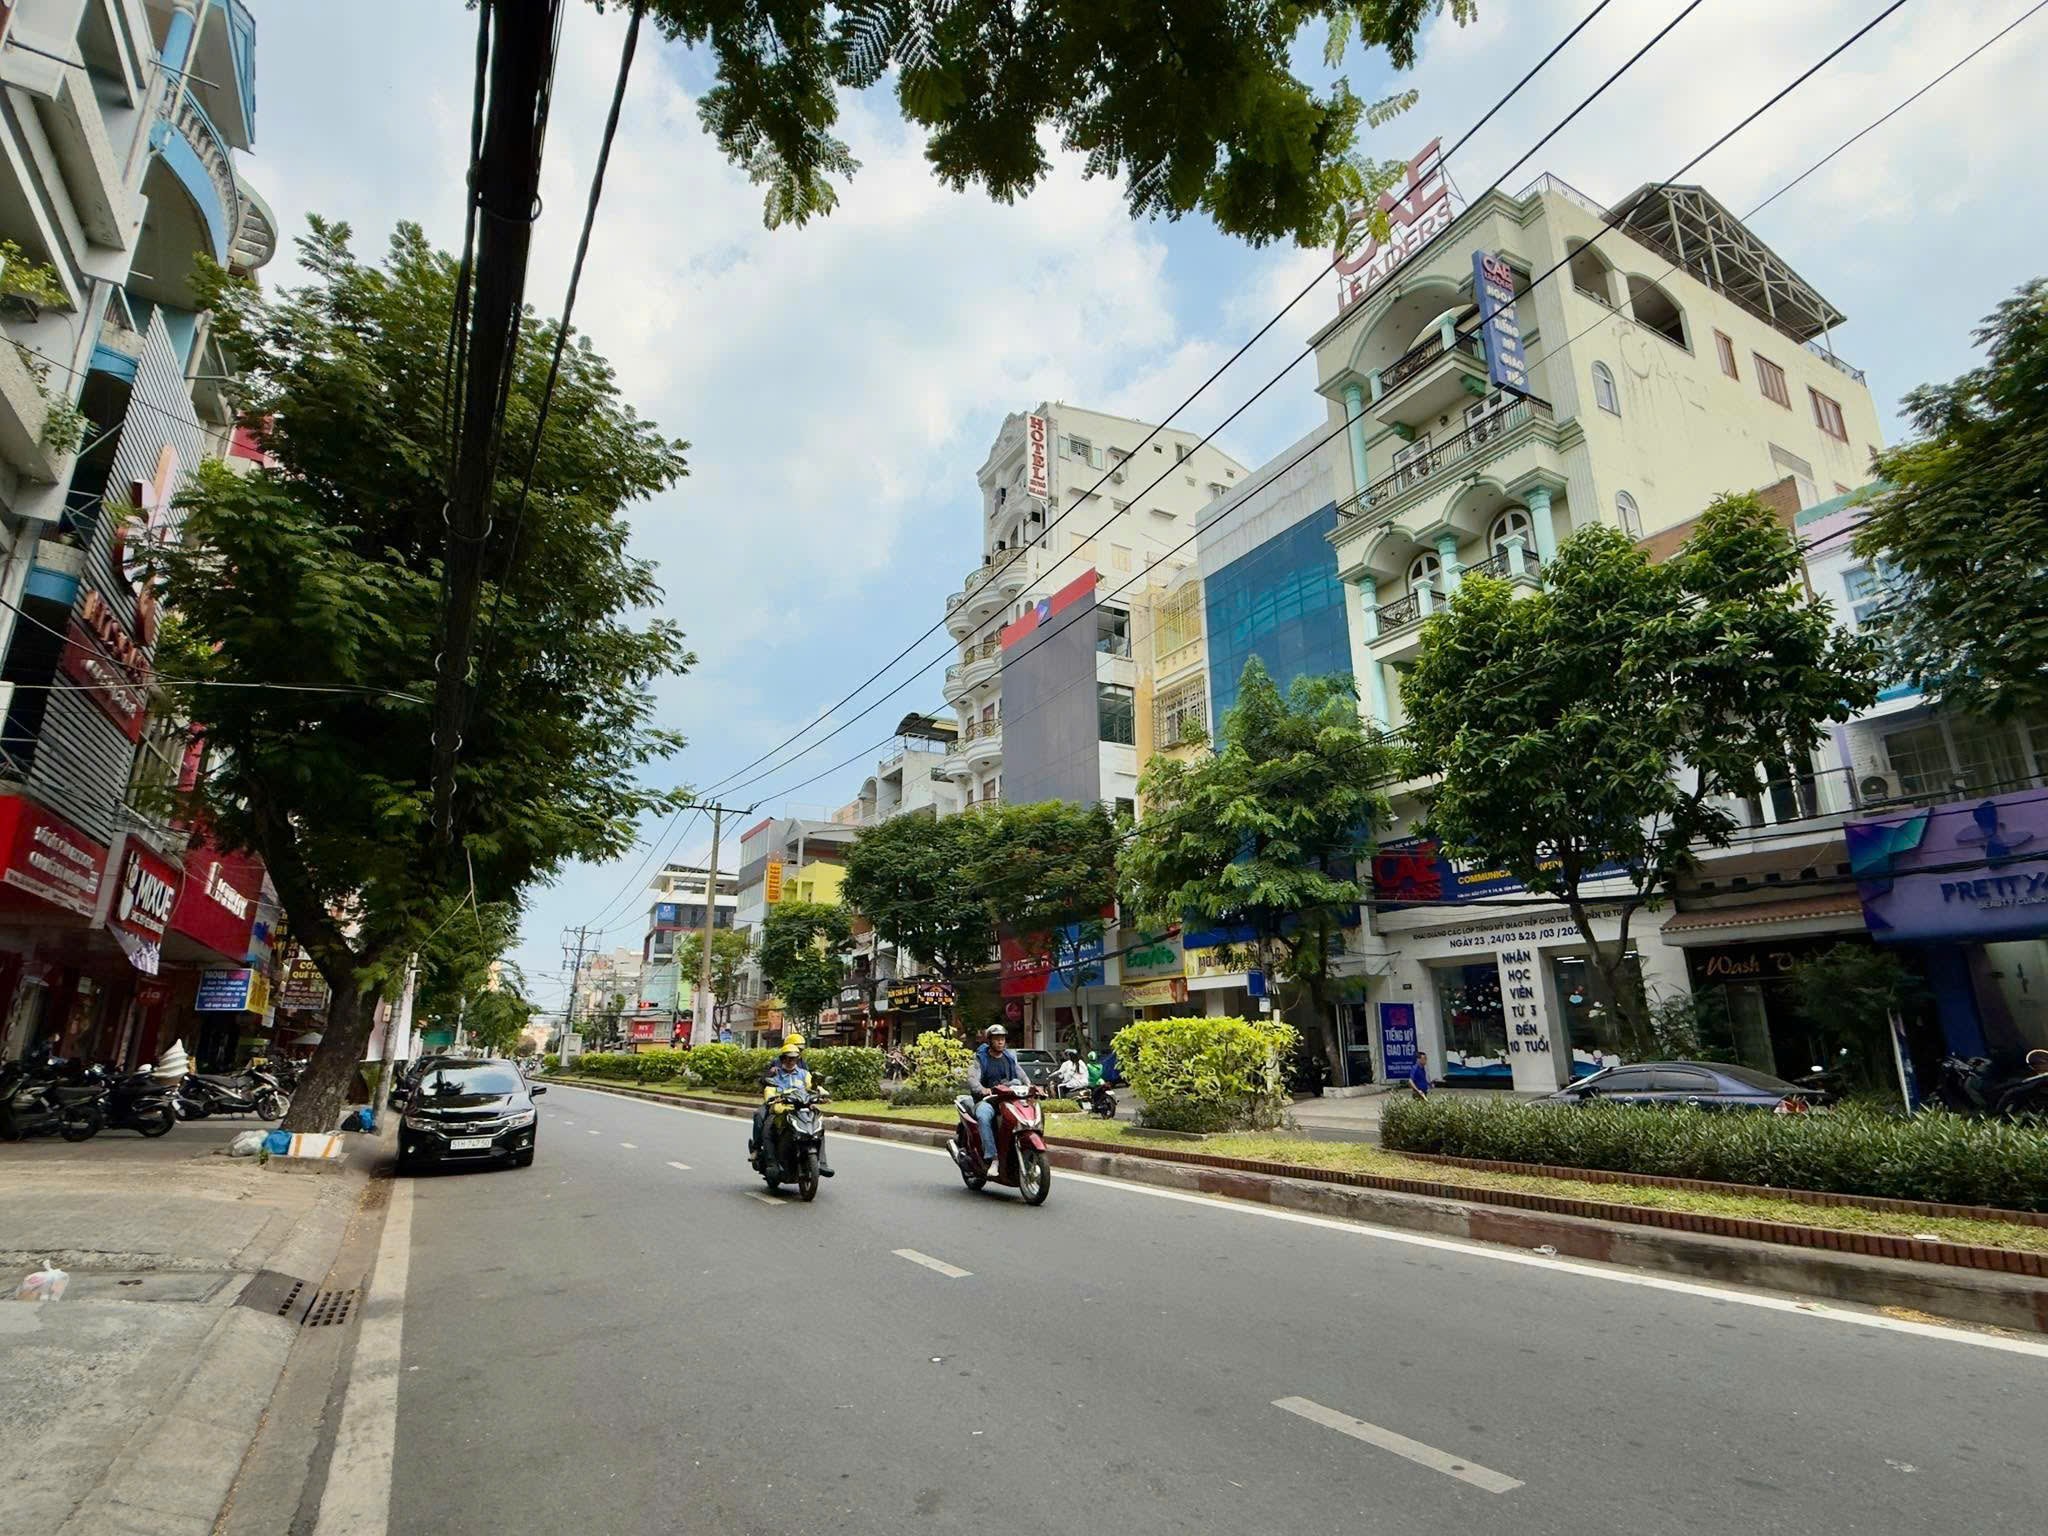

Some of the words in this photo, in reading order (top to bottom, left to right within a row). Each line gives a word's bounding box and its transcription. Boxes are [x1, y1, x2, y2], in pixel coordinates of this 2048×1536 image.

[1338, 199, 1455, 316] LEADERS
[1482, 255, 1512, 283] CAE
[1030, 416, 1046, 481] HOTEL
[1457, 869, 1513, 885] COMMUNICA
[135, 869, 175, 922] MIXUE
[1475, 923, 1494, 934] TIẾNG
[1505, 919, 1523, 929] GIAO
[1523, 915, 1538, 927] TIẾP
[1538, 915, 1556, 926] CHO
[1449, 936, 1473, 949] NGÀY
[1474, 936, 1485, 946] 23
[1556, 925, 1582, 938] /202
[1501, 949, 1532, 965] NHẬN
[1706, 953, 1761, 976] Wash
[1507, 968, 1531, 984] HỌC
[1509, 984, 1534, 1000] VIÊN
[1511, 1003, 1525, 1018] TỪ
[1530, 1004, 1537, 1017] 3
[1384, 1026, 1404, 1042] TIẾNG
[1404, 1027, 1414, 1042] MỸ
[1515, 1019, 1538, 1036] ĐẾN
[1386, 1044, 1401, 1056] GIAO
[1401, 1041, 1416, 1056] TIẾP
[1509, 1040, 1520, 1053] 10
[1525, 1034, 1550, 1053] TUỔI
